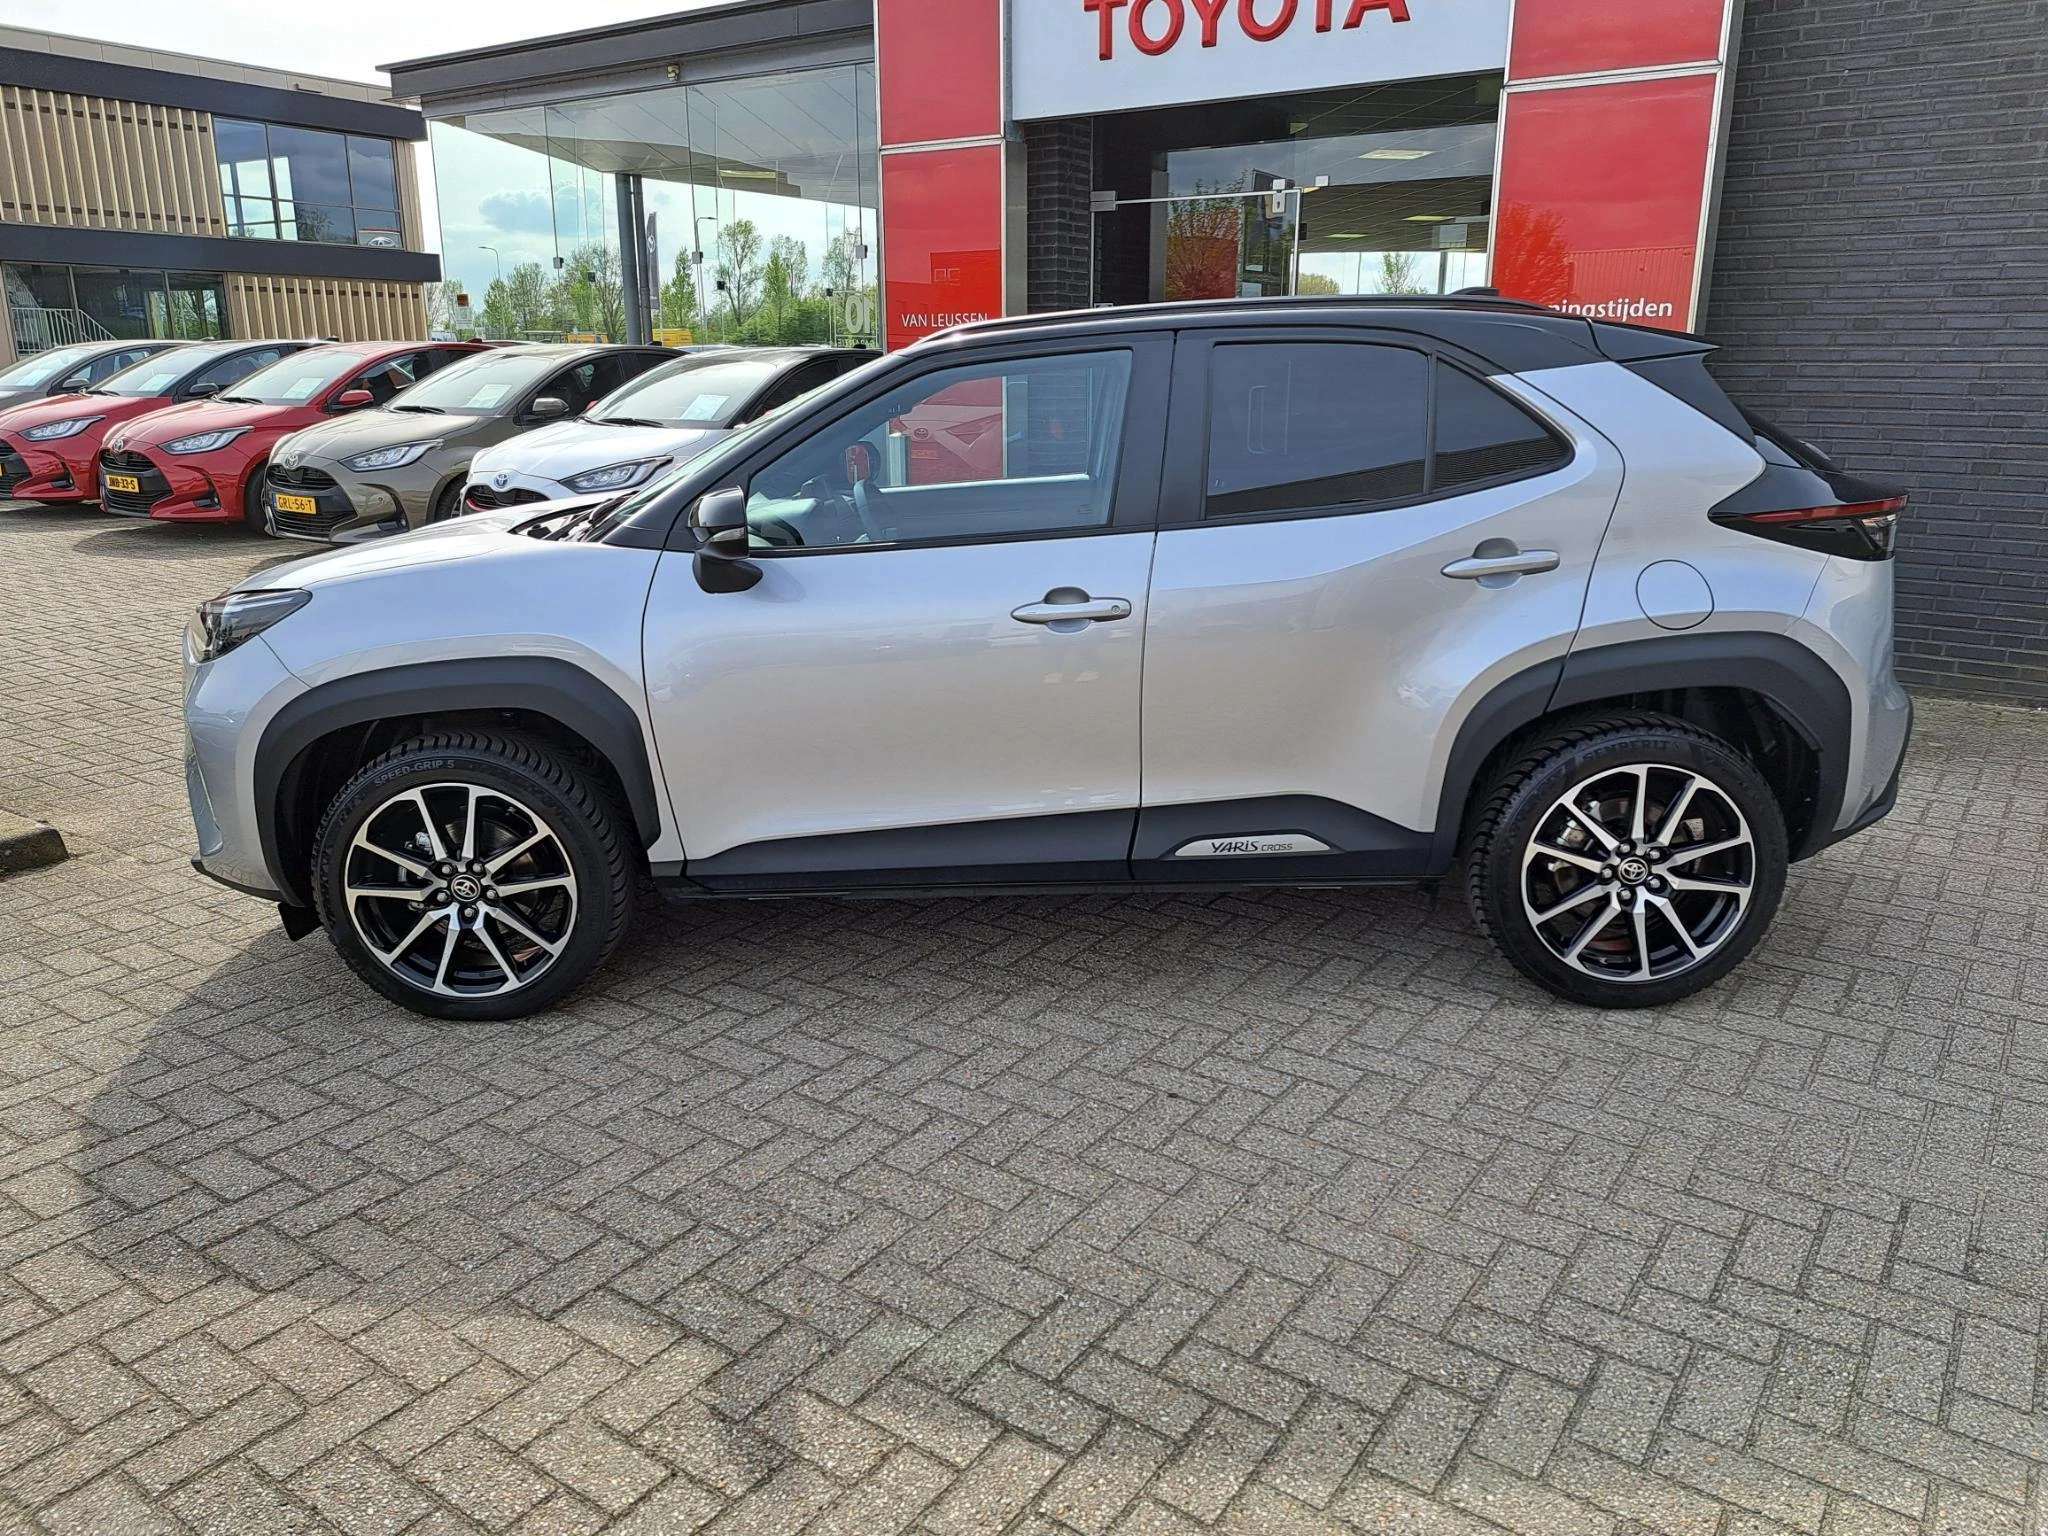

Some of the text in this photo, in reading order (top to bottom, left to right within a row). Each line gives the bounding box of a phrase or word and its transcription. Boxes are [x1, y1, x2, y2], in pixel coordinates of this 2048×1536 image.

[1548, 297, 1672, 322] ingstijden
[901, 312, 988, 327] VAN LEUSSEN
[278, 496, 313, 511] GRL-56-T
[374, 759, 455, 787] SPEED-GRIP 5
[1211, 840, 1293, 854] YARIS CROSS
